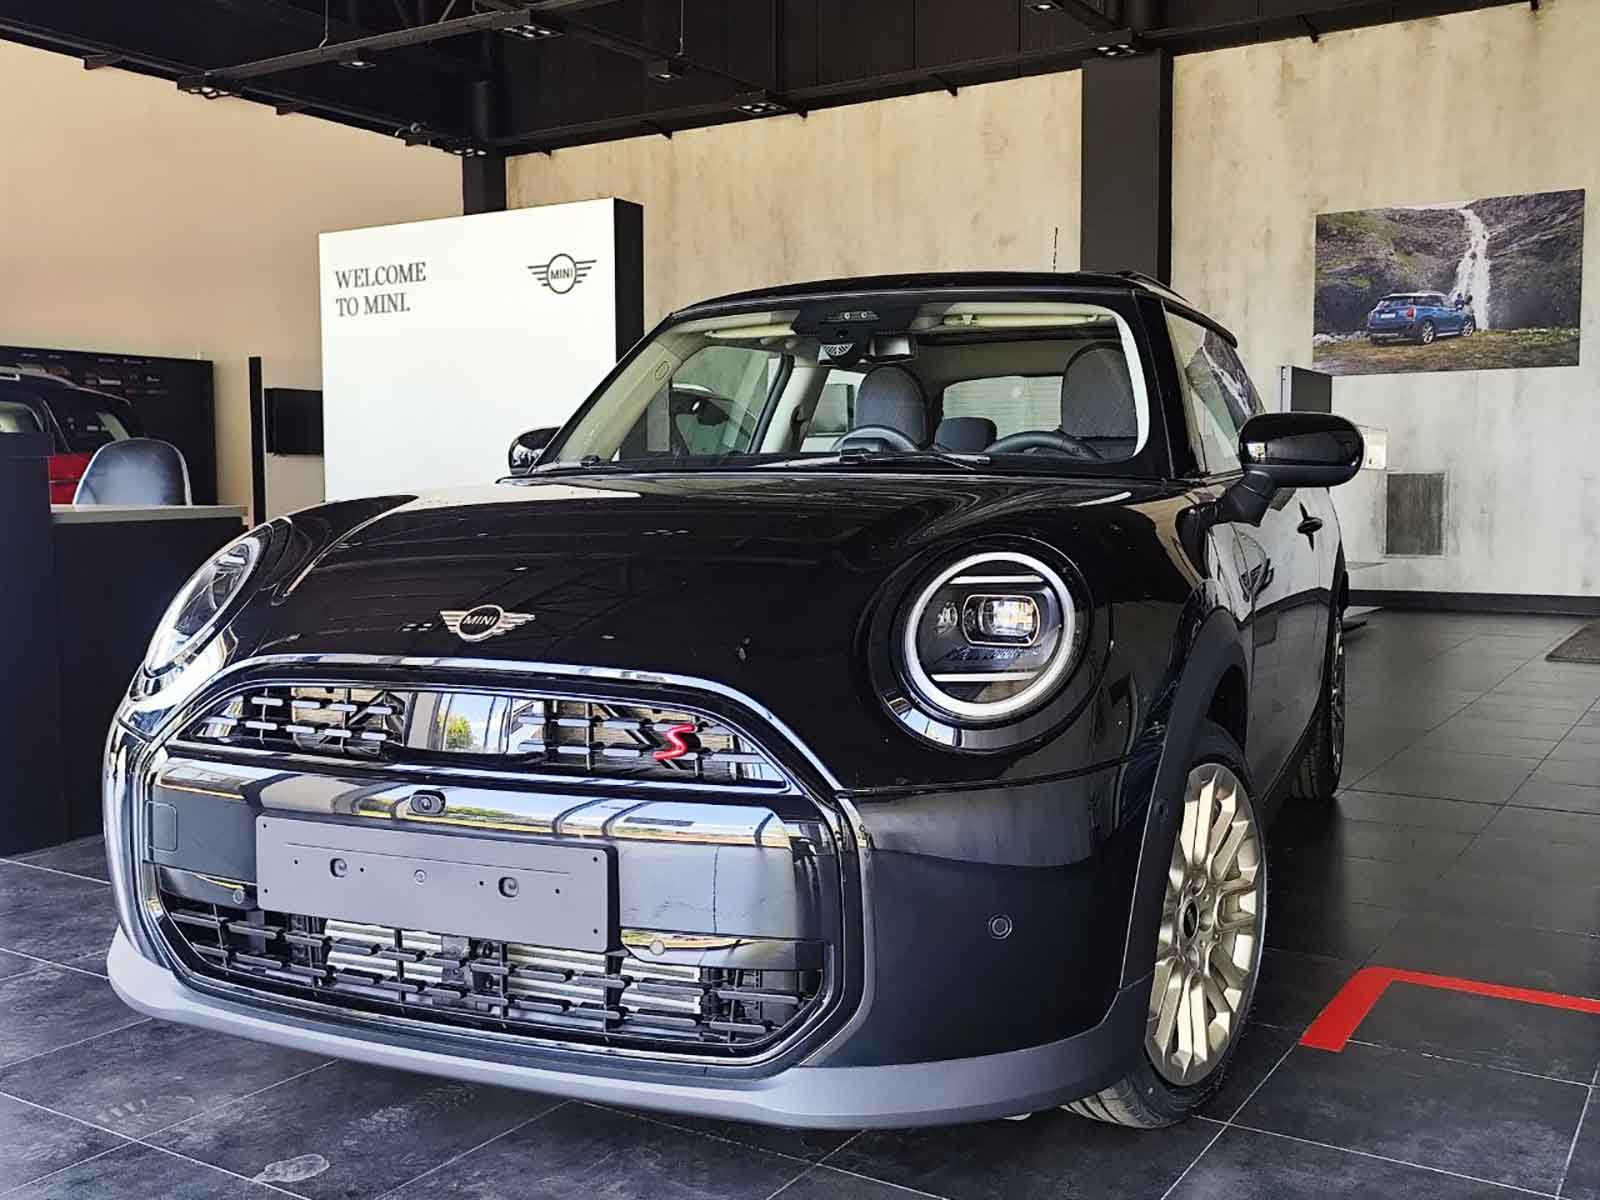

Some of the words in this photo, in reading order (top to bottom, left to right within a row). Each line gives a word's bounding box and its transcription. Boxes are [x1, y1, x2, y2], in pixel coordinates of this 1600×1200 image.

[335, 261, 426, 289] WELCOME
[550, 268, 574, 280] MINI
[335, 297, 359, 317] TO
[363, 292, 411, 315] MINI.
[463, 615, 497, 626] MINI
[653, 722, 696, 761] S
